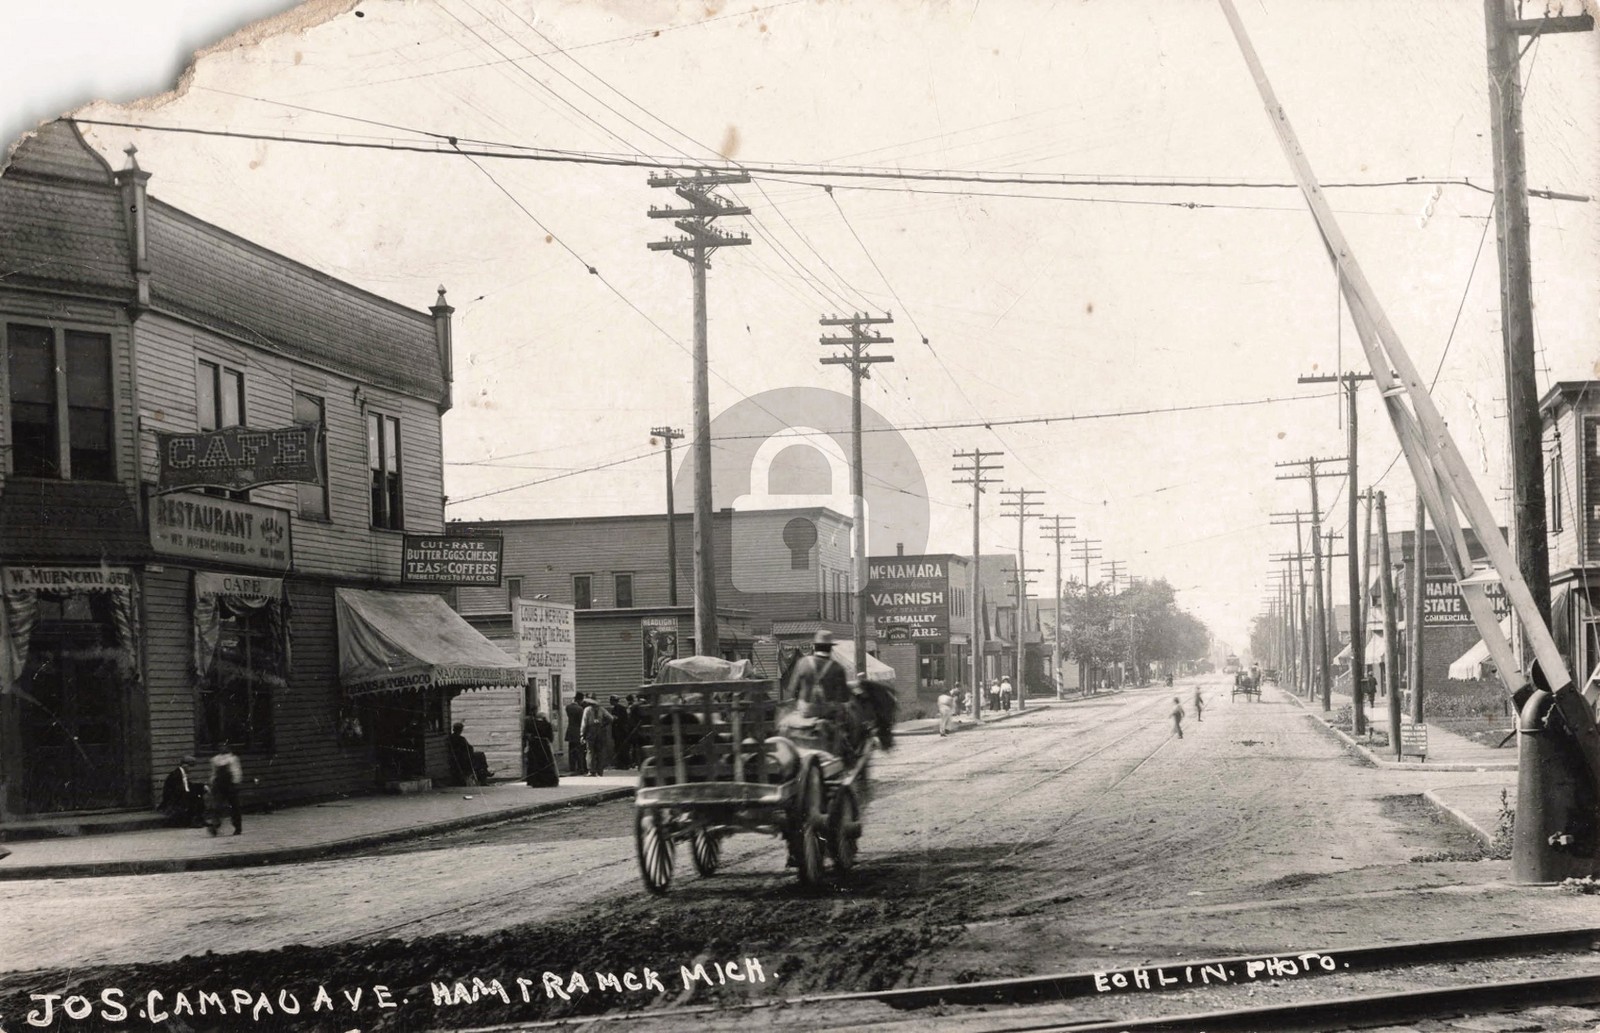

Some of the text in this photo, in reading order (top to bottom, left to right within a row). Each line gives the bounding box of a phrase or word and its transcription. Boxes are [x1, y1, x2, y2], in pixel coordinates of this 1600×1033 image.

[169, 432, 306, 469] CAFE
[157, 498, 253, 540] RESTAURANT
[420, 540, 485, 550] CUT-RATE
[466, 550, 498, 562] CHEESE
[408, 562, 440, 573] TEAS
[448, 562, 497, 575] COFFEES
[435, 573, 451, 581] PAYS
[223, 578, 261, 593] CAFE
[870, 592, 943, 606] VARNISH
[1424, 599, 1461, 613] STATE
[1424, 614, 1469, 622] COMMERCIAL
[386, 674, 431, 688] TOBACCO
